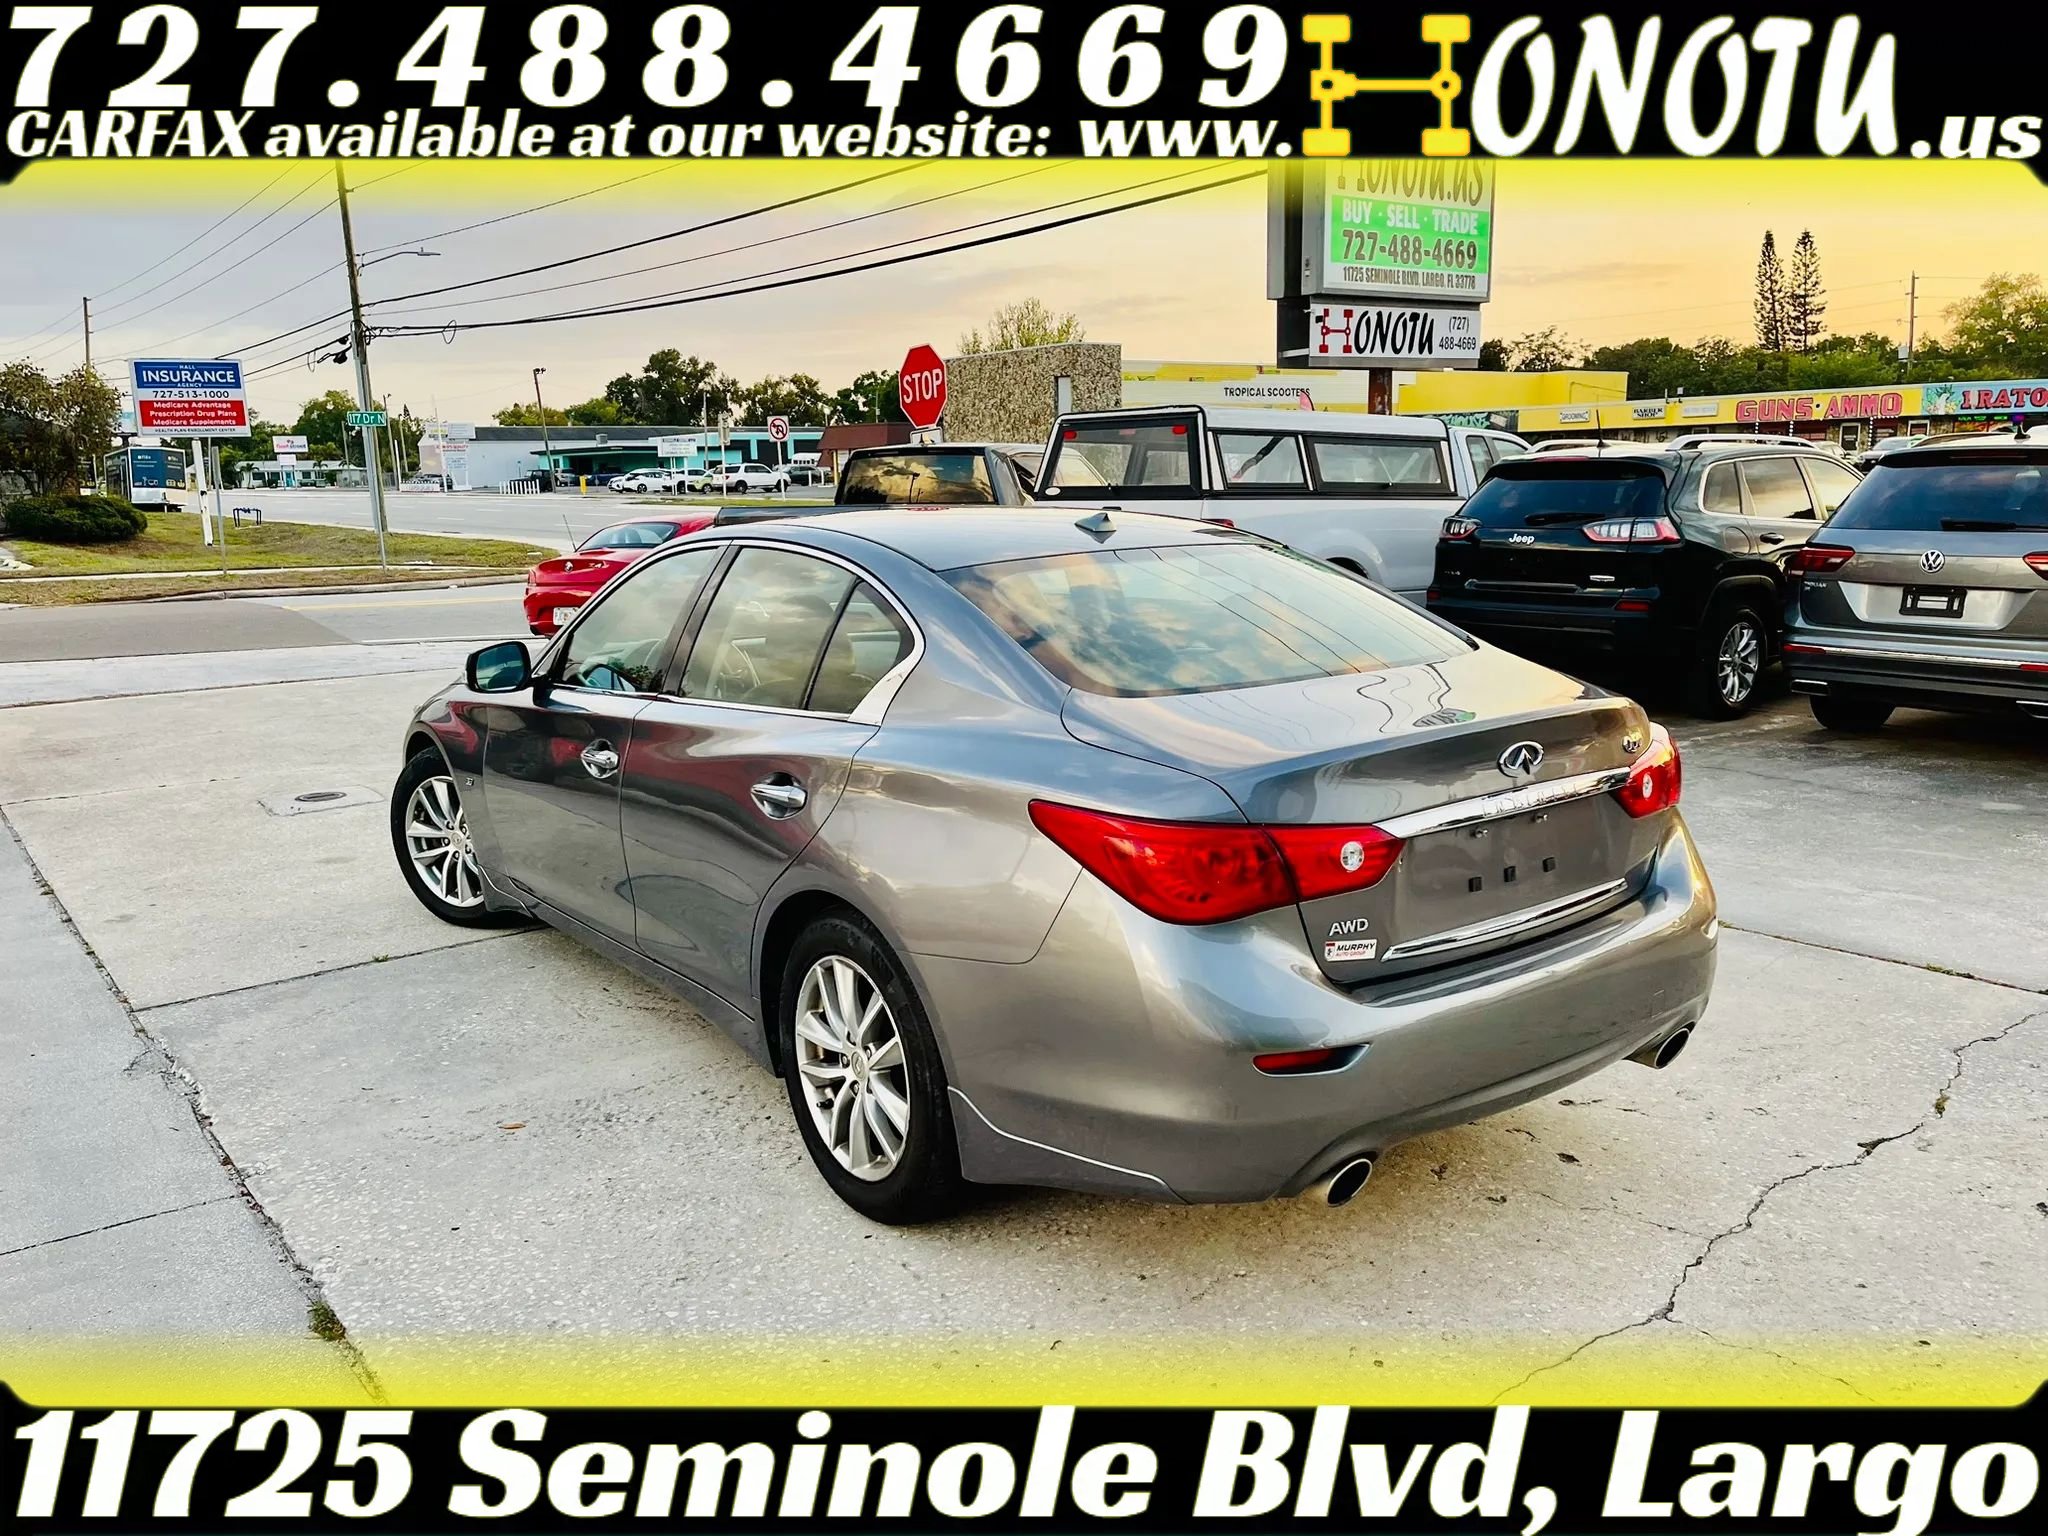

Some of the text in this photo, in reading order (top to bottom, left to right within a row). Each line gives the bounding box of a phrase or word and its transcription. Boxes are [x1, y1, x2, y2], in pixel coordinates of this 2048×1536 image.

[1342, 198, 1479, 235] BUY SELL TRADE
[1342, 229, 1477, 269] 727-488-4669
[1343, 266, 1364, 283] 11725
[1365, 268, 1401, 285] SEMINOLE
[1447, 274, 1455, 288] FL
[1455, 275, 1476, 290] 33778
[1448, 316, 1470, 333] (727)
[1438, 336, 1477, 351] 488-4669
[142, 370, 236, 383] INSURANCE
[902, 368, 943, 404] STOP
[1223, 387, 1266, 397] TROPICAL
[152, 390, 230, 399] 727-513-1000
[191, 402, 232, 410] Advantage
[1735, 392, 1904, 422] GUNS AMMO
[149, 410, 195, 418] Prescription
[348, 413, 386, 425] 117 Dr N
[189, 419, 236, 427] Supplements
[1508, 533, 1535, 545] Jeep
[1328, 918, 1370, 937] AWD
[1336, 942, 1376, 952] MURPHY
